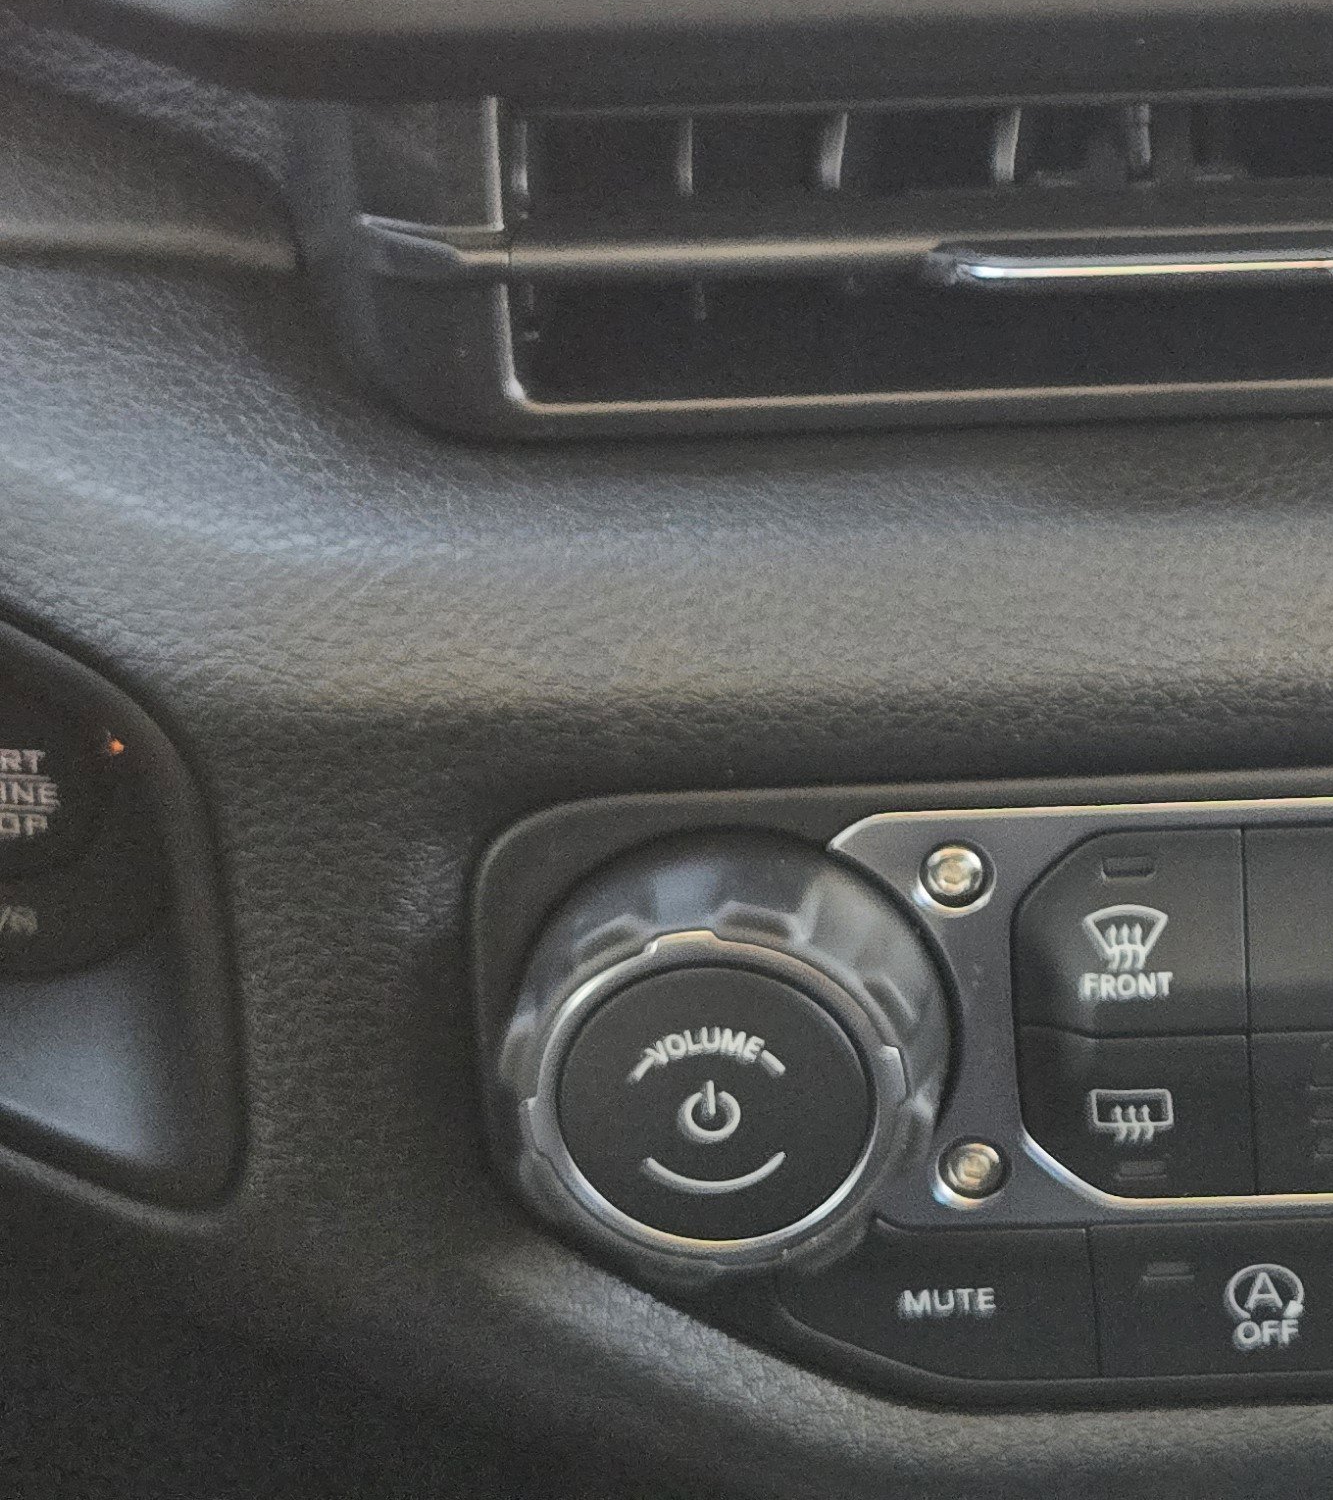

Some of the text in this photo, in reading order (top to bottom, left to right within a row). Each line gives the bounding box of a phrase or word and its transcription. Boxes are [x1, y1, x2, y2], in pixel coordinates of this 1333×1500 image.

[1080, 971, 1174, 1000] FRONT
[643, 1027, 766, 1067] VOLUME
[901, 1287, 997, 1318] MUTE
[1235, 1318, 1299, 1348] OFF
